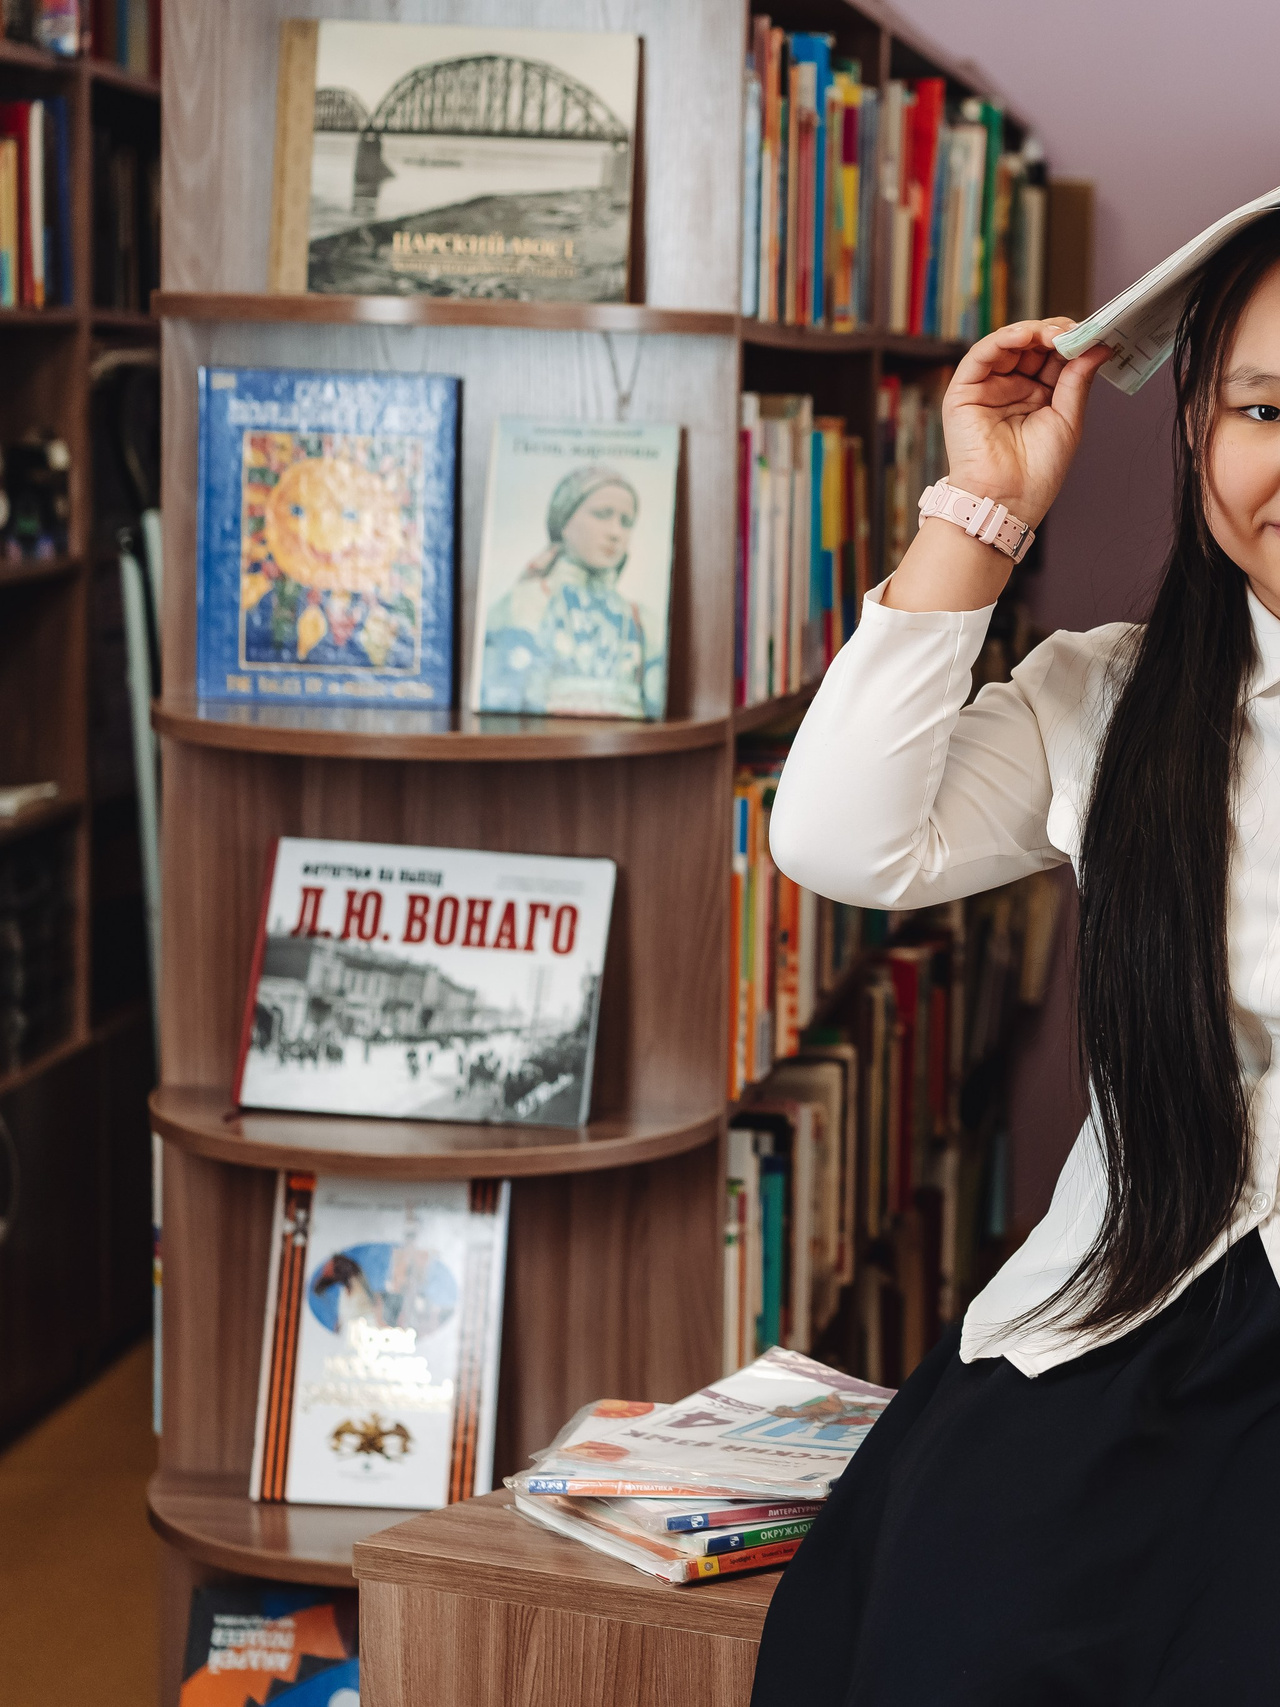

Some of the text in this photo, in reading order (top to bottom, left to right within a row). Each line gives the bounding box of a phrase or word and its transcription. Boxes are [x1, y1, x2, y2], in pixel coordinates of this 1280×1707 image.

[340, 887, 390, 942] Ю.
[402, 893, 579, 955] ВОНАГО
[666, 1411, 735, 1429] 4
[720, 1445, 849, 1461] УССКИЙ
[767, 1504, 822, 1517] ЛИТЕРАТУРНО
[760, 1523, 813, 1540] ОКРУЖАЮ
